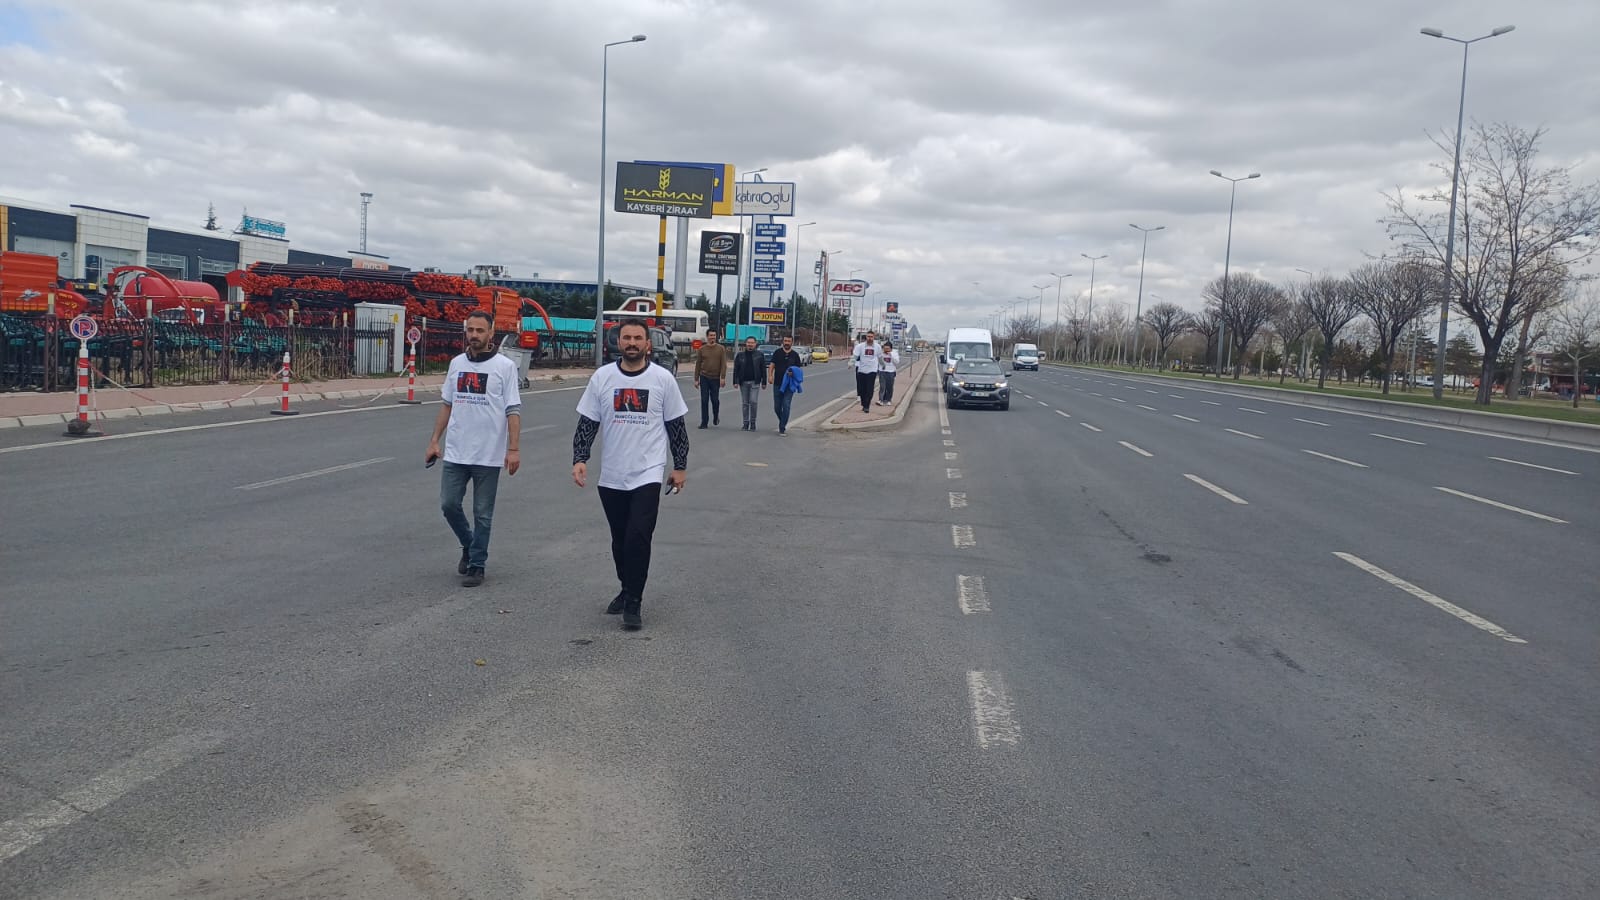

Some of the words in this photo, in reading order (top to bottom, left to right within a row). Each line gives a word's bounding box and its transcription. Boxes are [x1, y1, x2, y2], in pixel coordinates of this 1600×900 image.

[623, 188, 703, 201] HARMAN
[626, 202, 665, 213] KAYSERİ
[666, 205, 699, 215] ZİRAAT
